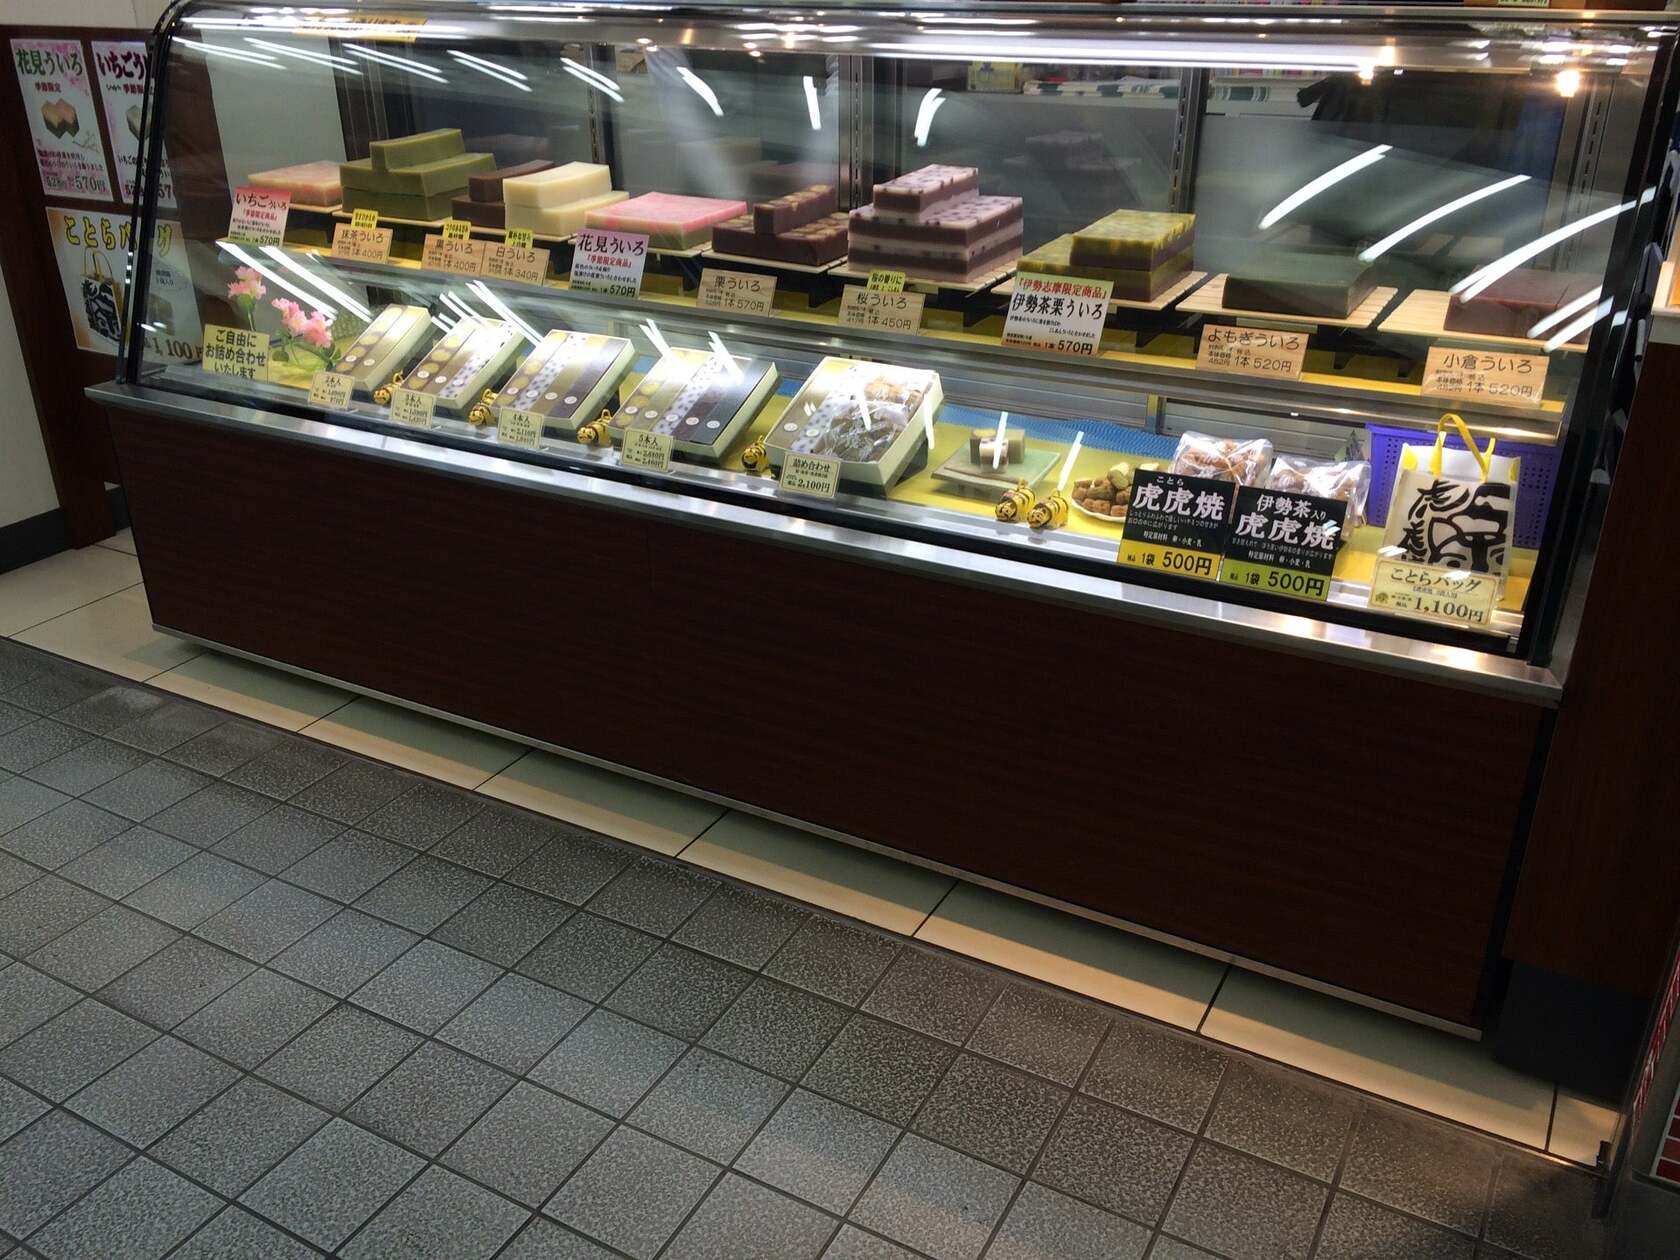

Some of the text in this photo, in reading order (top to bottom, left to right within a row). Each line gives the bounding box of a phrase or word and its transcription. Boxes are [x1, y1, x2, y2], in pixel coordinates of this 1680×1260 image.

[16, 48, 83, 76] 花見ういろ
[236, 193, 287, 210] いちごういろ
[341, 229, 384, 243] 抹茶ういろ
[578, 233, 644, 257] 花見ういろ
[496, 246, 536, 263] 白ういろ
[610, 285, 636, 297] 570円
[714, 275, 760, 292] 栗ういろ
[737, 299, 765, 312] 570円
[856, 292, 907, 309] 桜ういろ
[1012, 292, 1103, 320] 伊勢茶栗ういろ
[881, 317, 912, 330] 450円
[216, 329, 257, 348] ご自由に
[1208, 328, 1300, 350] よもぎういろ
[205, 343, 266, 367] お詰め合わせ
[1058, 340, 1093, 355] 570円
[214, 362, 256, 379] いたします
[1235, 356, 1292, 372] 1本 520円
[1443, 353, 1532, 374] 小倉ういろ
[1467, 381, 1533, 397] 1本 520円
[793, 458, 831, 473] 詰め合わせ
[797, 479, 831, 493] 2,100円
[1156, 476, 1185, 486] ことら
[1132, 482, 1226, 522] 虎虎焼
[1256, 494, 1327, 521] 伊勢茶入り
[1235, 512, 1336, 550] 虎虎焼
[1142, 552, 1156, 566] 1袋
[1162, 551, 1212, 575] 500円
[1245, 572, 1260, 586] 1袋
[1267, 571, 1325, 596] 500円
[1391, 568, 1482, 592] ことらバッグ
[1414, 597, 1484, 622] 1,100円
